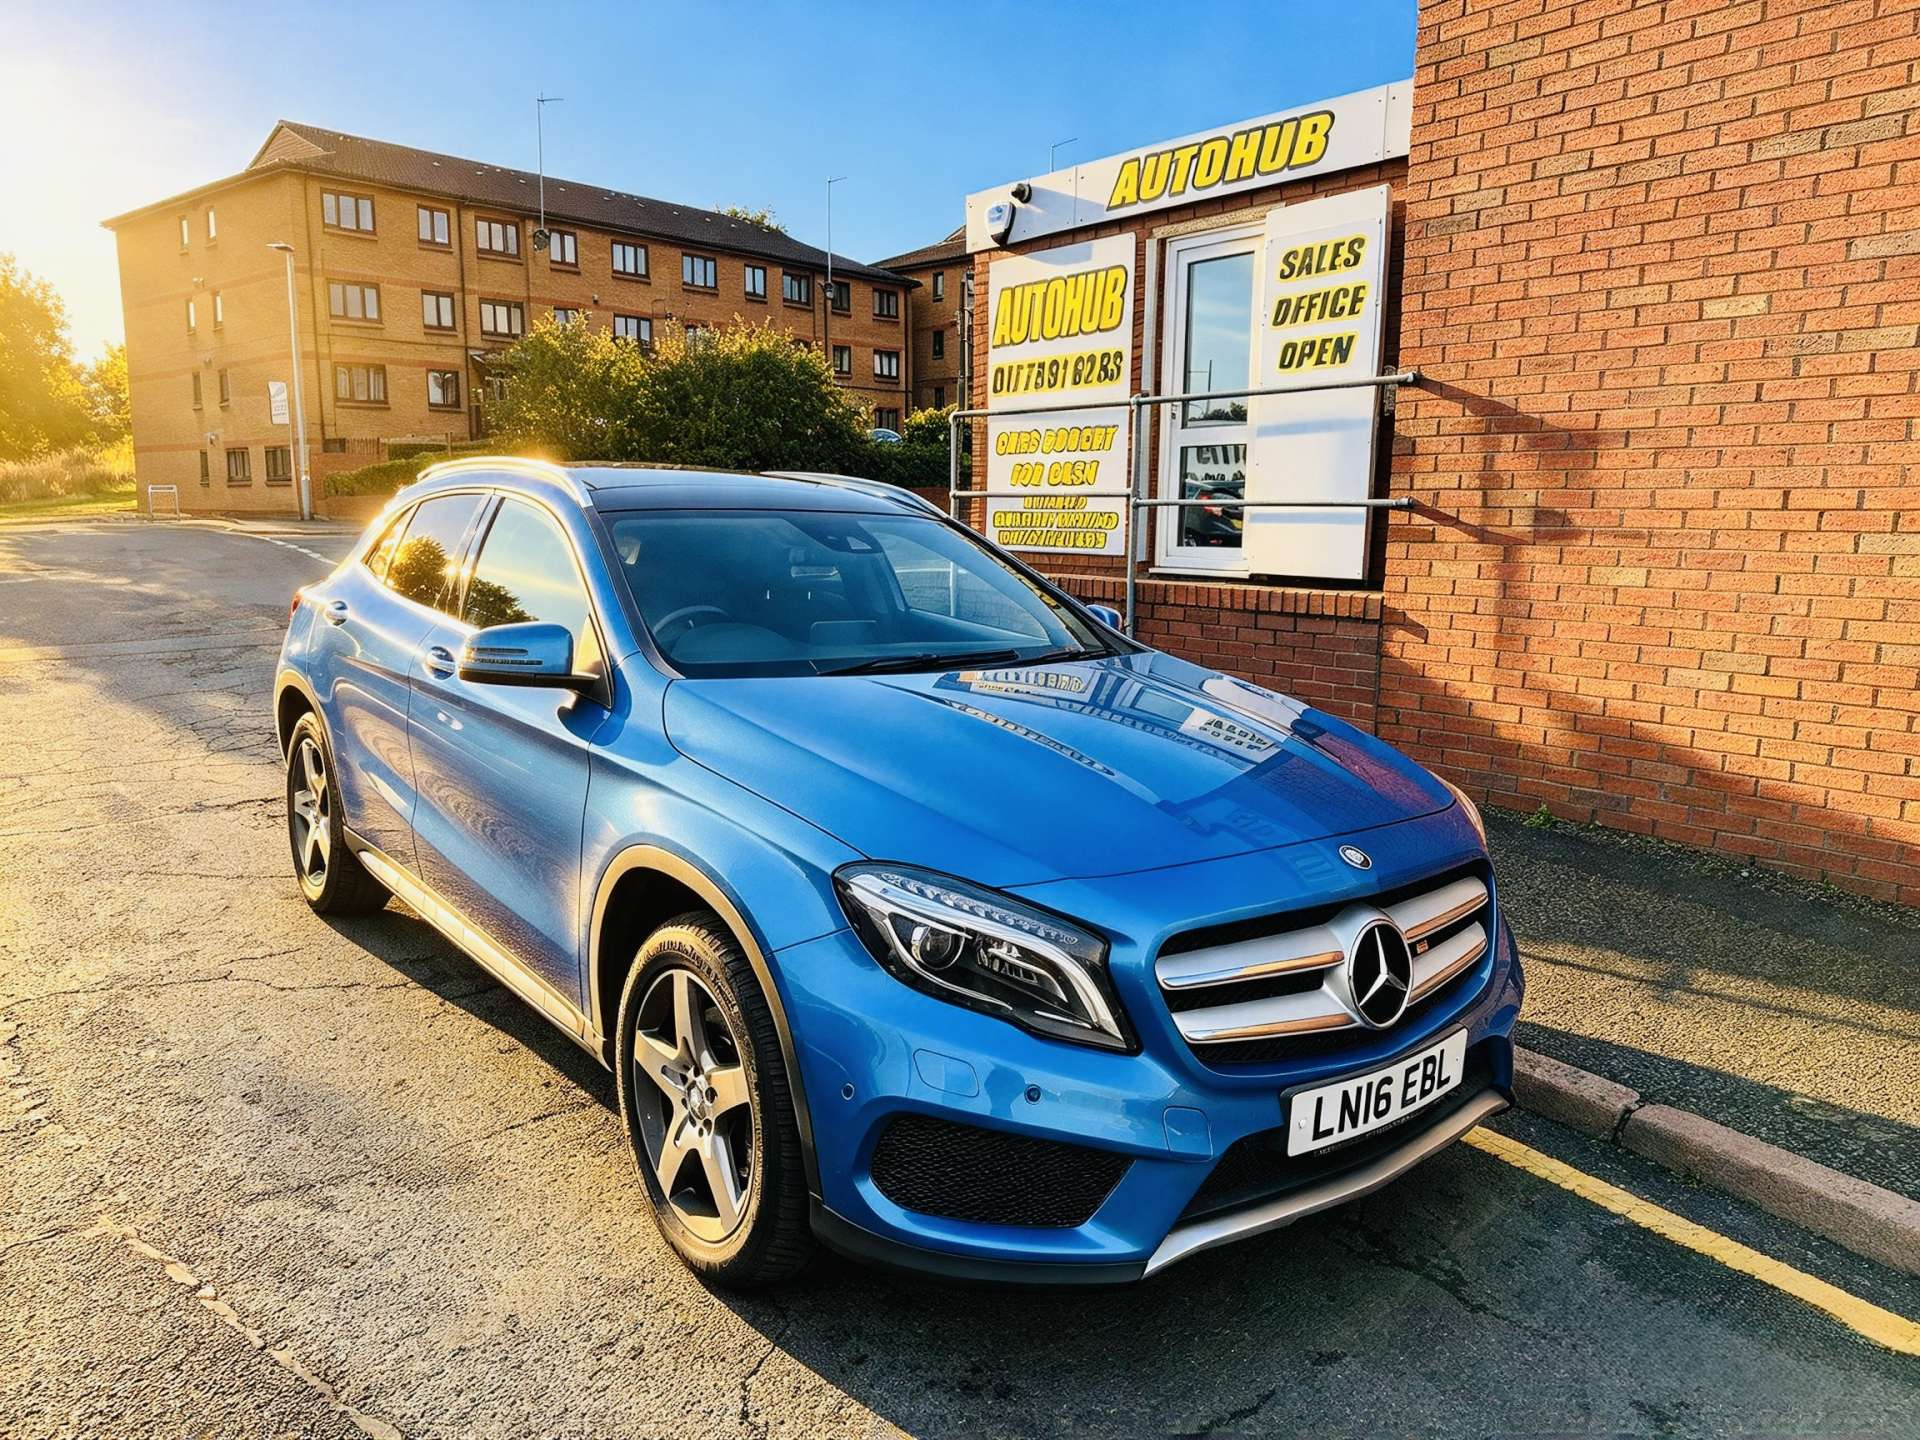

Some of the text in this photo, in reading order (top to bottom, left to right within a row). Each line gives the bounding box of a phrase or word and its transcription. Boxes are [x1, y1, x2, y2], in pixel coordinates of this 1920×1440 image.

[1106, 110, 1335, 211] AUTOHUB
[1280, 237, 1366, 279] SALES
[992, 265, 1128, 348] AUTOHUB
[1272, 285, 1366, 327] OFFICE
[1278, 334, 1356, 370] OPEN
[1312, 1075, 1394, 1142] LN16
[1400, 1048, 1452, 1110] EBL
